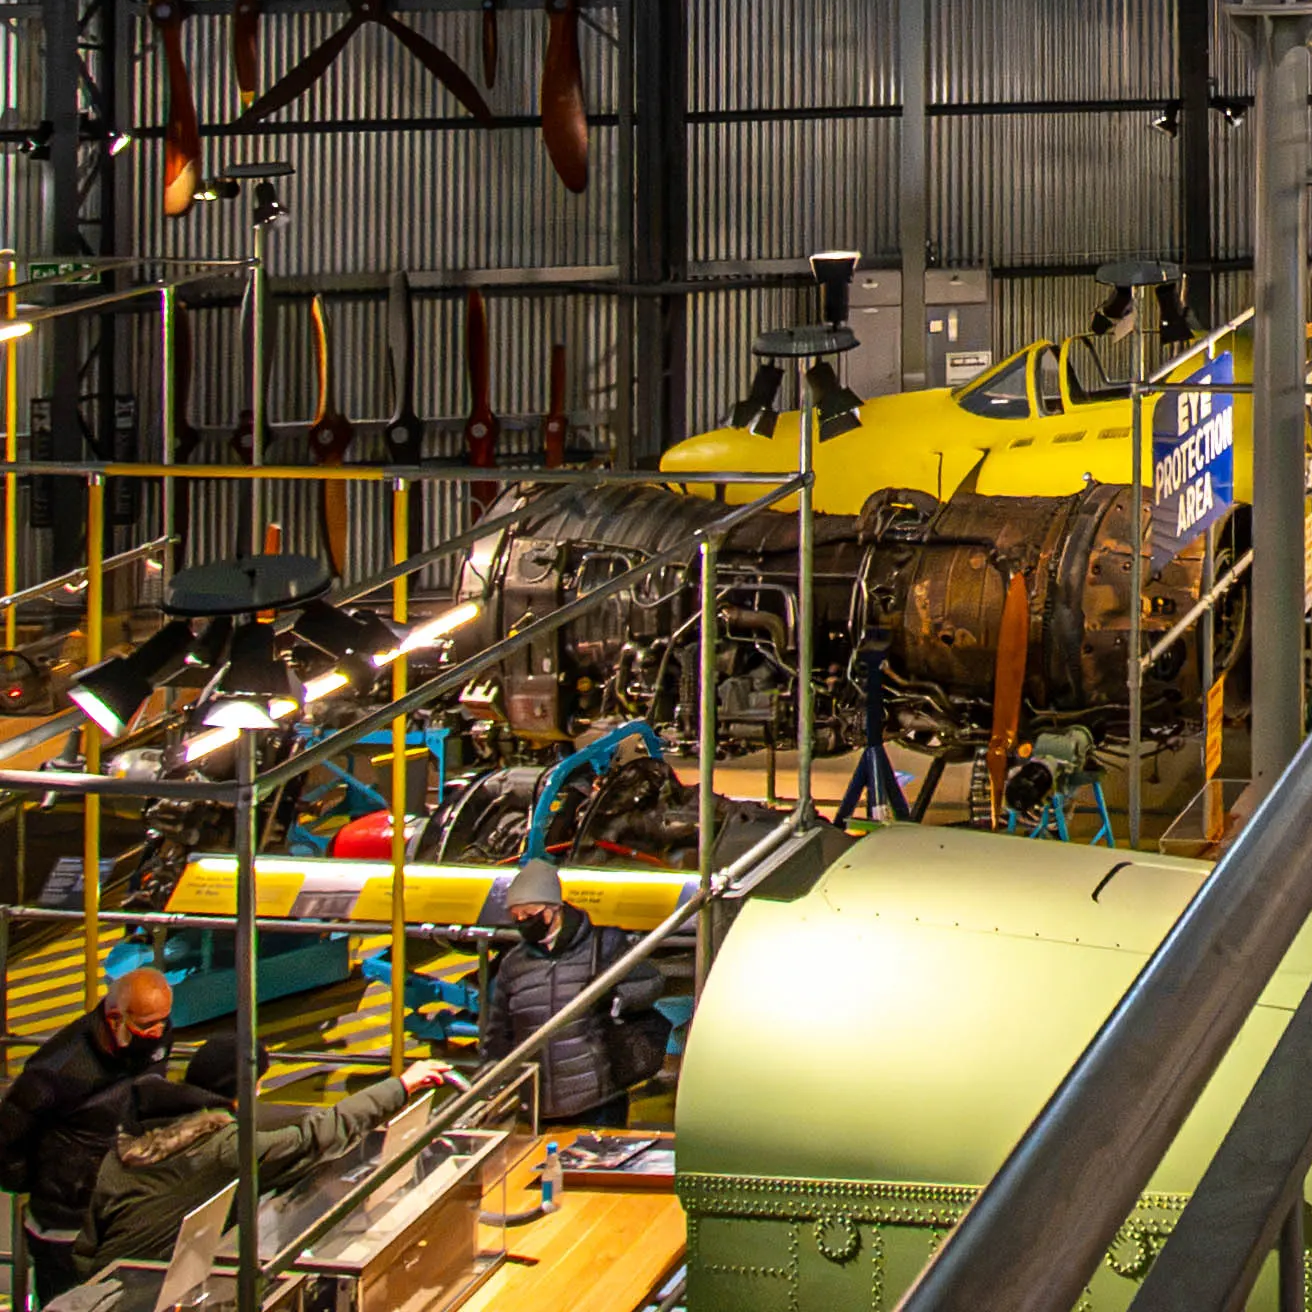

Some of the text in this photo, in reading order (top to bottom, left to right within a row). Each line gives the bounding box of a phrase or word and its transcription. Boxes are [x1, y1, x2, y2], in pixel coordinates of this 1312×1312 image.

[1177, 375, 1213, 437] EYE
[1155, 405, 1233, 506] PROTECTION
[1176, 471, 1214, 538] AREA
